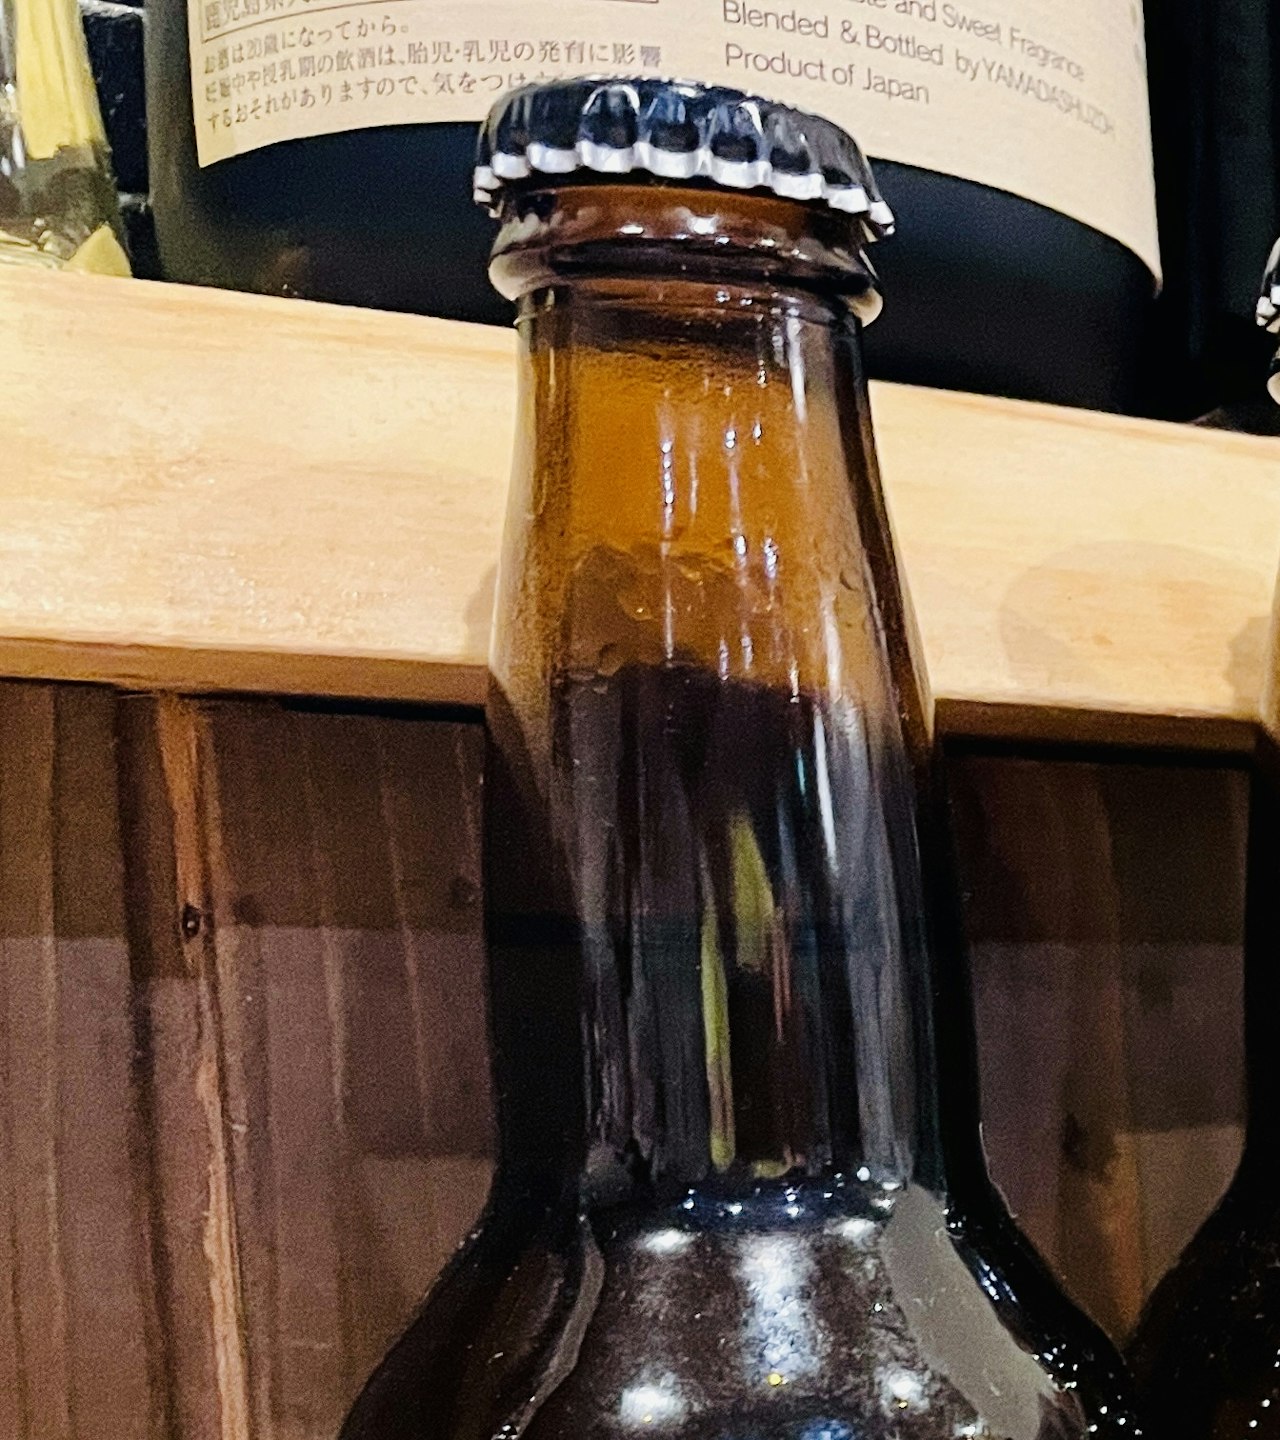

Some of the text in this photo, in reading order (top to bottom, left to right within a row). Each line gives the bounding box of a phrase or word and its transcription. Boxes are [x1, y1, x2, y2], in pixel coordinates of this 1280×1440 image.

[722, 0, 829, 39] Blended
[865, 24, 944, 67] Bottled
[725, 42, 930, 105] Product of Japan
